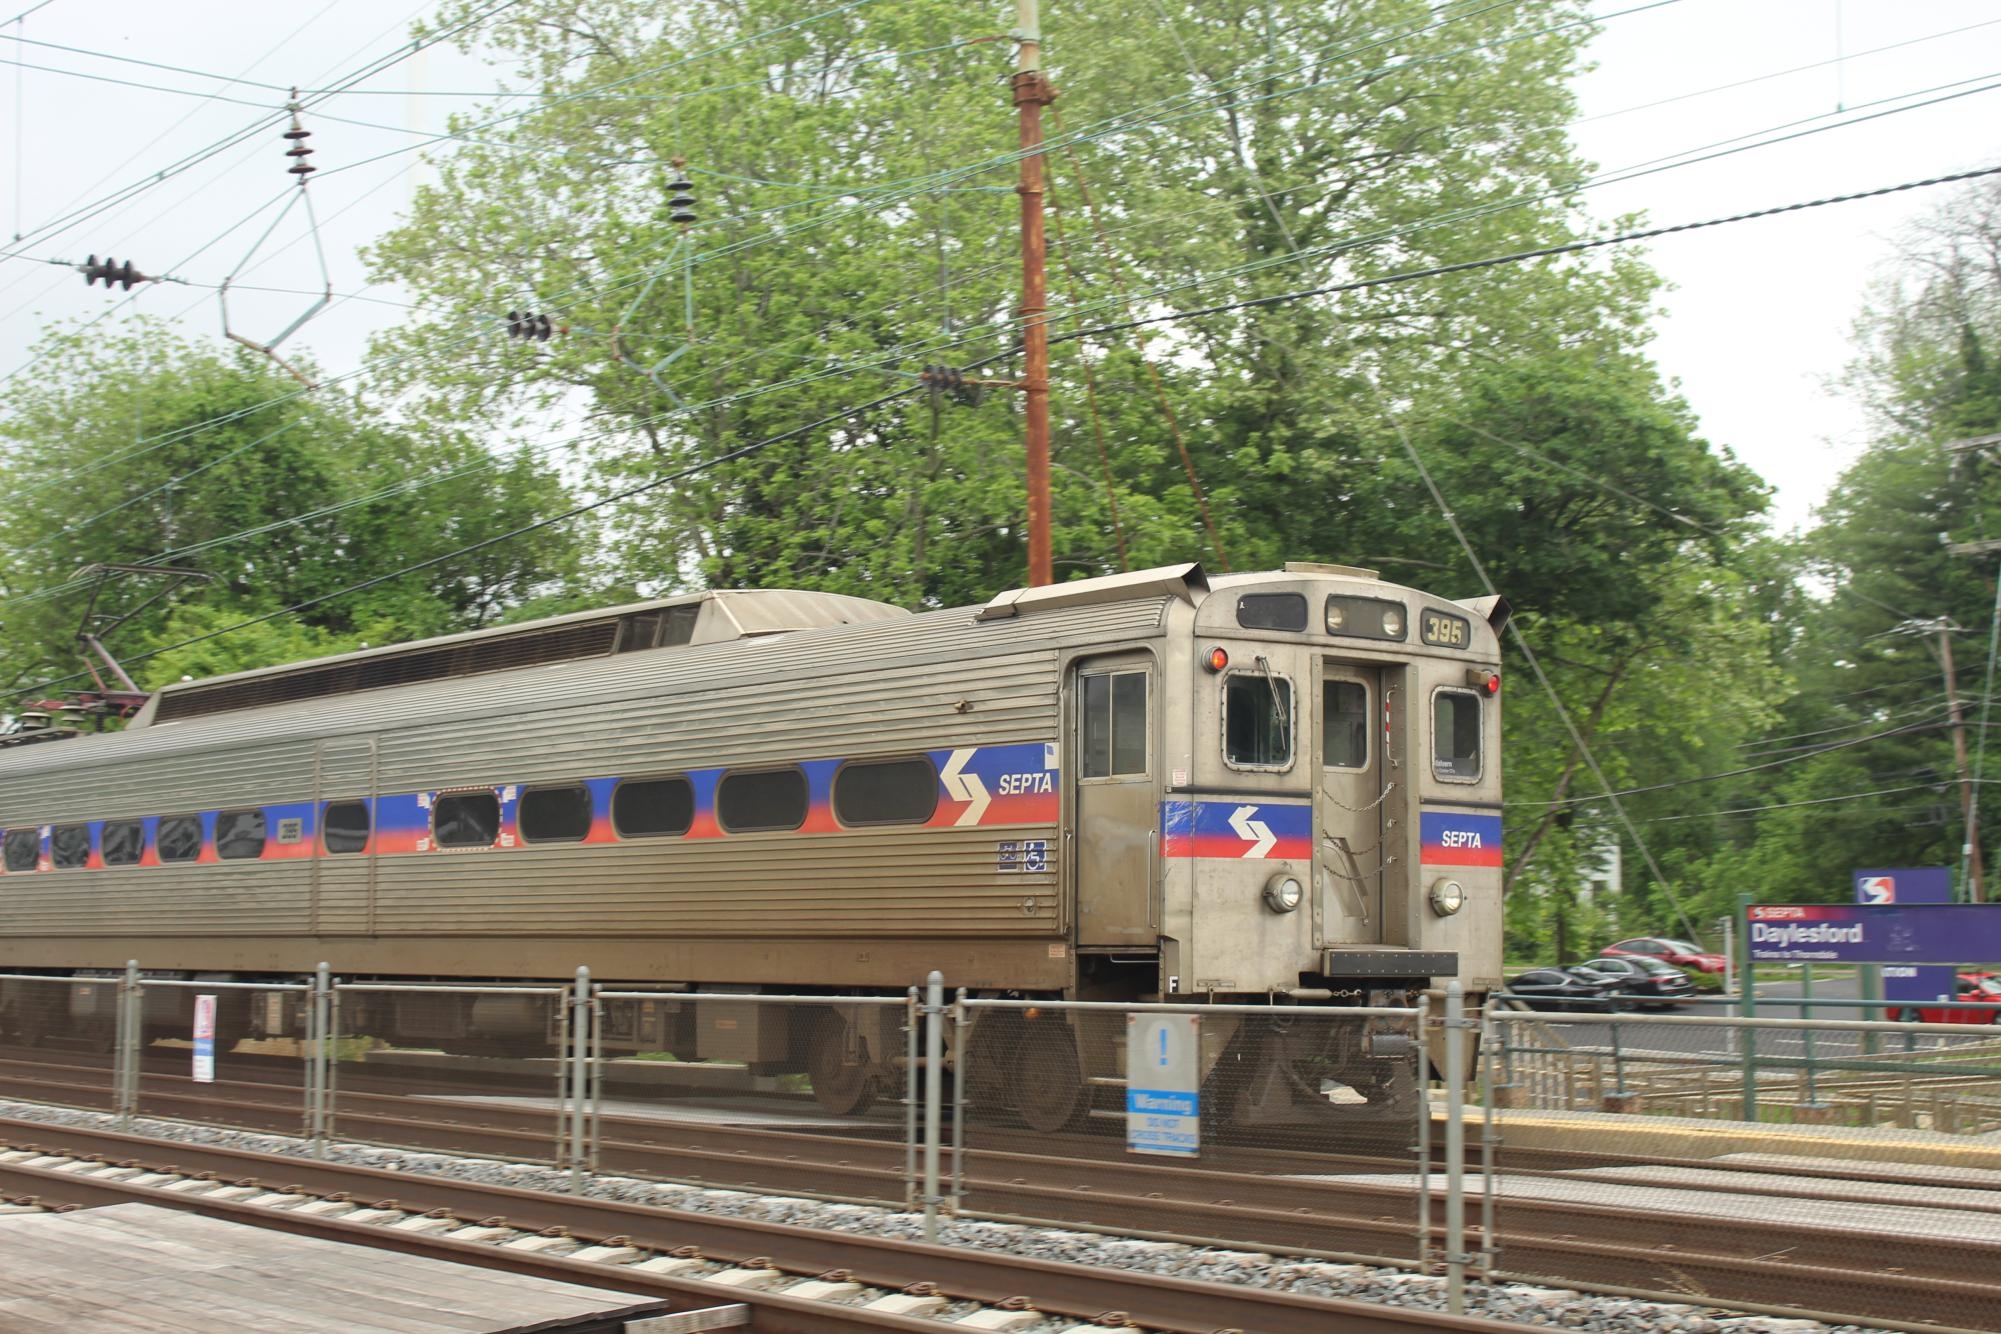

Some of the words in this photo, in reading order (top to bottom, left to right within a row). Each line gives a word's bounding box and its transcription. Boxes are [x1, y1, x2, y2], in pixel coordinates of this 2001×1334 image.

[1427, 616, 1463, 645] 395
[998, 772, 1052, 795] SEPTA
[1441, 829, 1482, 849] SEPTA
[1765, 906, 1805, 918] SEPTA
[1751, 922, 1863, 947] Daylesford
[1169, 976, 1178, 993] F
[1134, 1094, 1193, 1115] Warning
